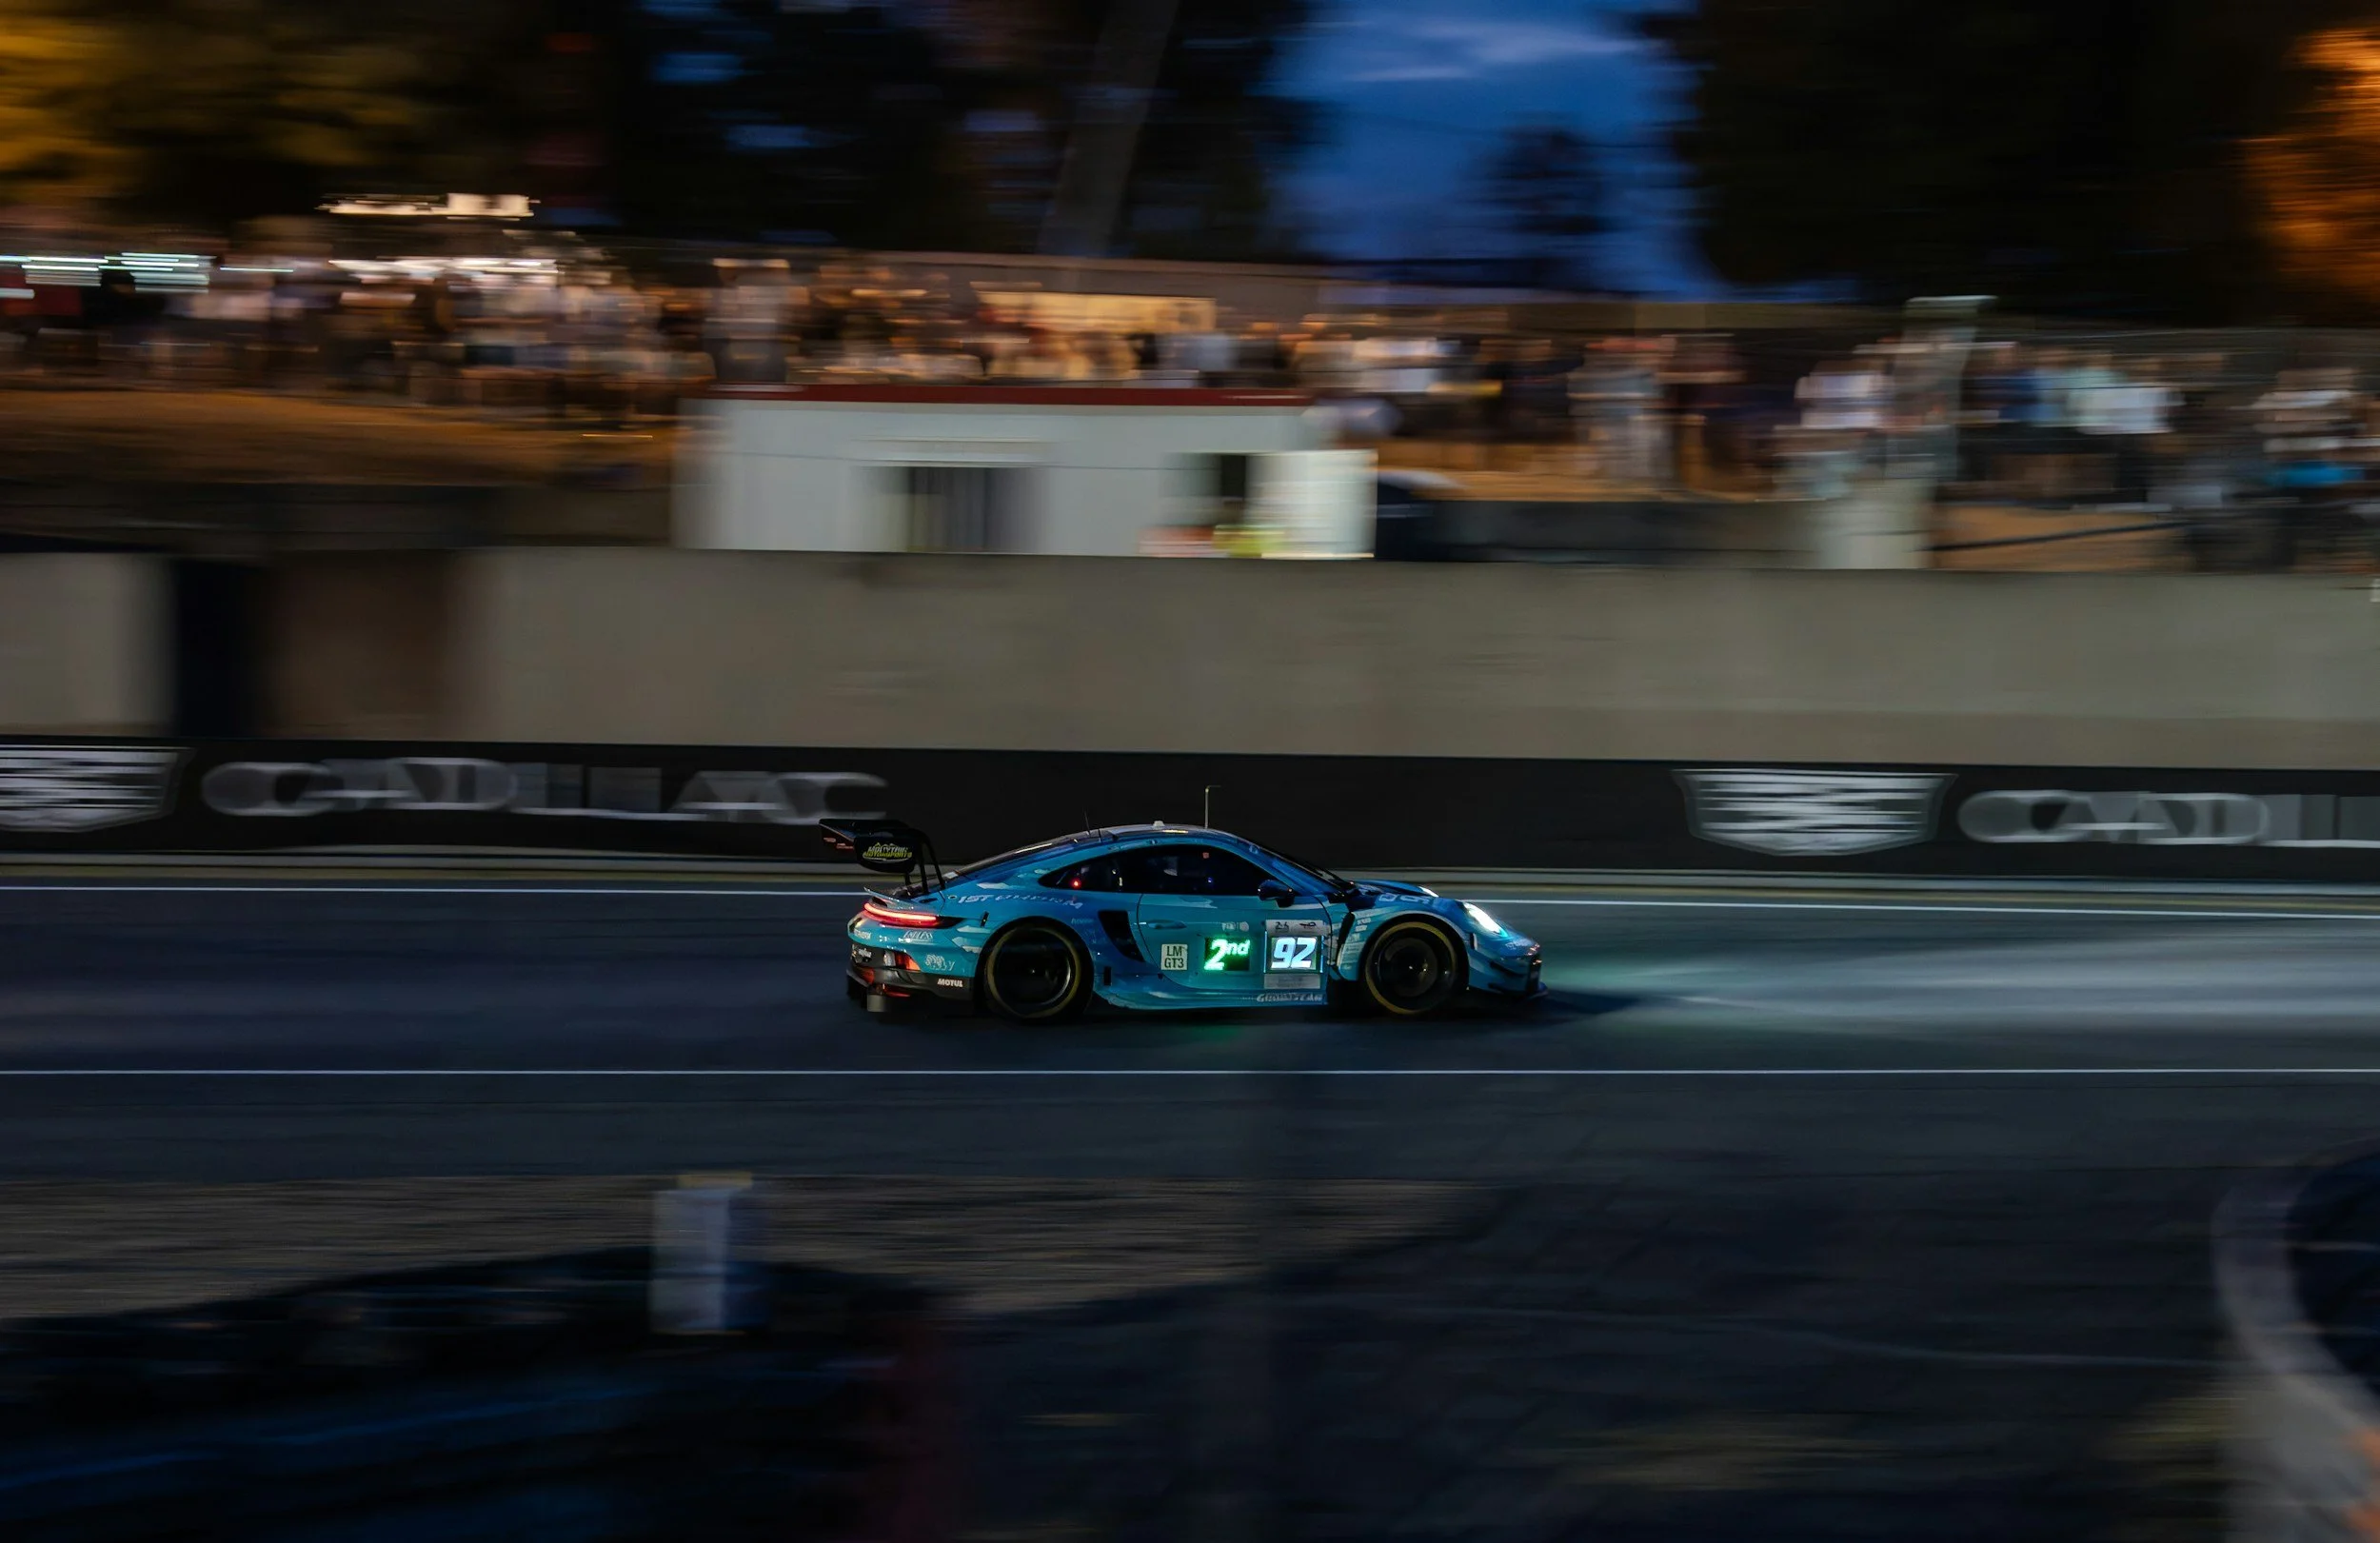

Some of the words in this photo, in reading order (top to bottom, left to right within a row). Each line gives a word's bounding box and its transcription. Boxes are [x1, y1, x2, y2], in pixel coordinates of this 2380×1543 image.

[199, 756, 889, 824] CADILLAC
[1166, 945, 1182, 957] LM
[1203, 939, 1251, 971] 2nd
[1270, 937, 1317, 969] 92
[1163, 958, 1184, 969] GT3
[937, 978, 963, 988] MOTUL
